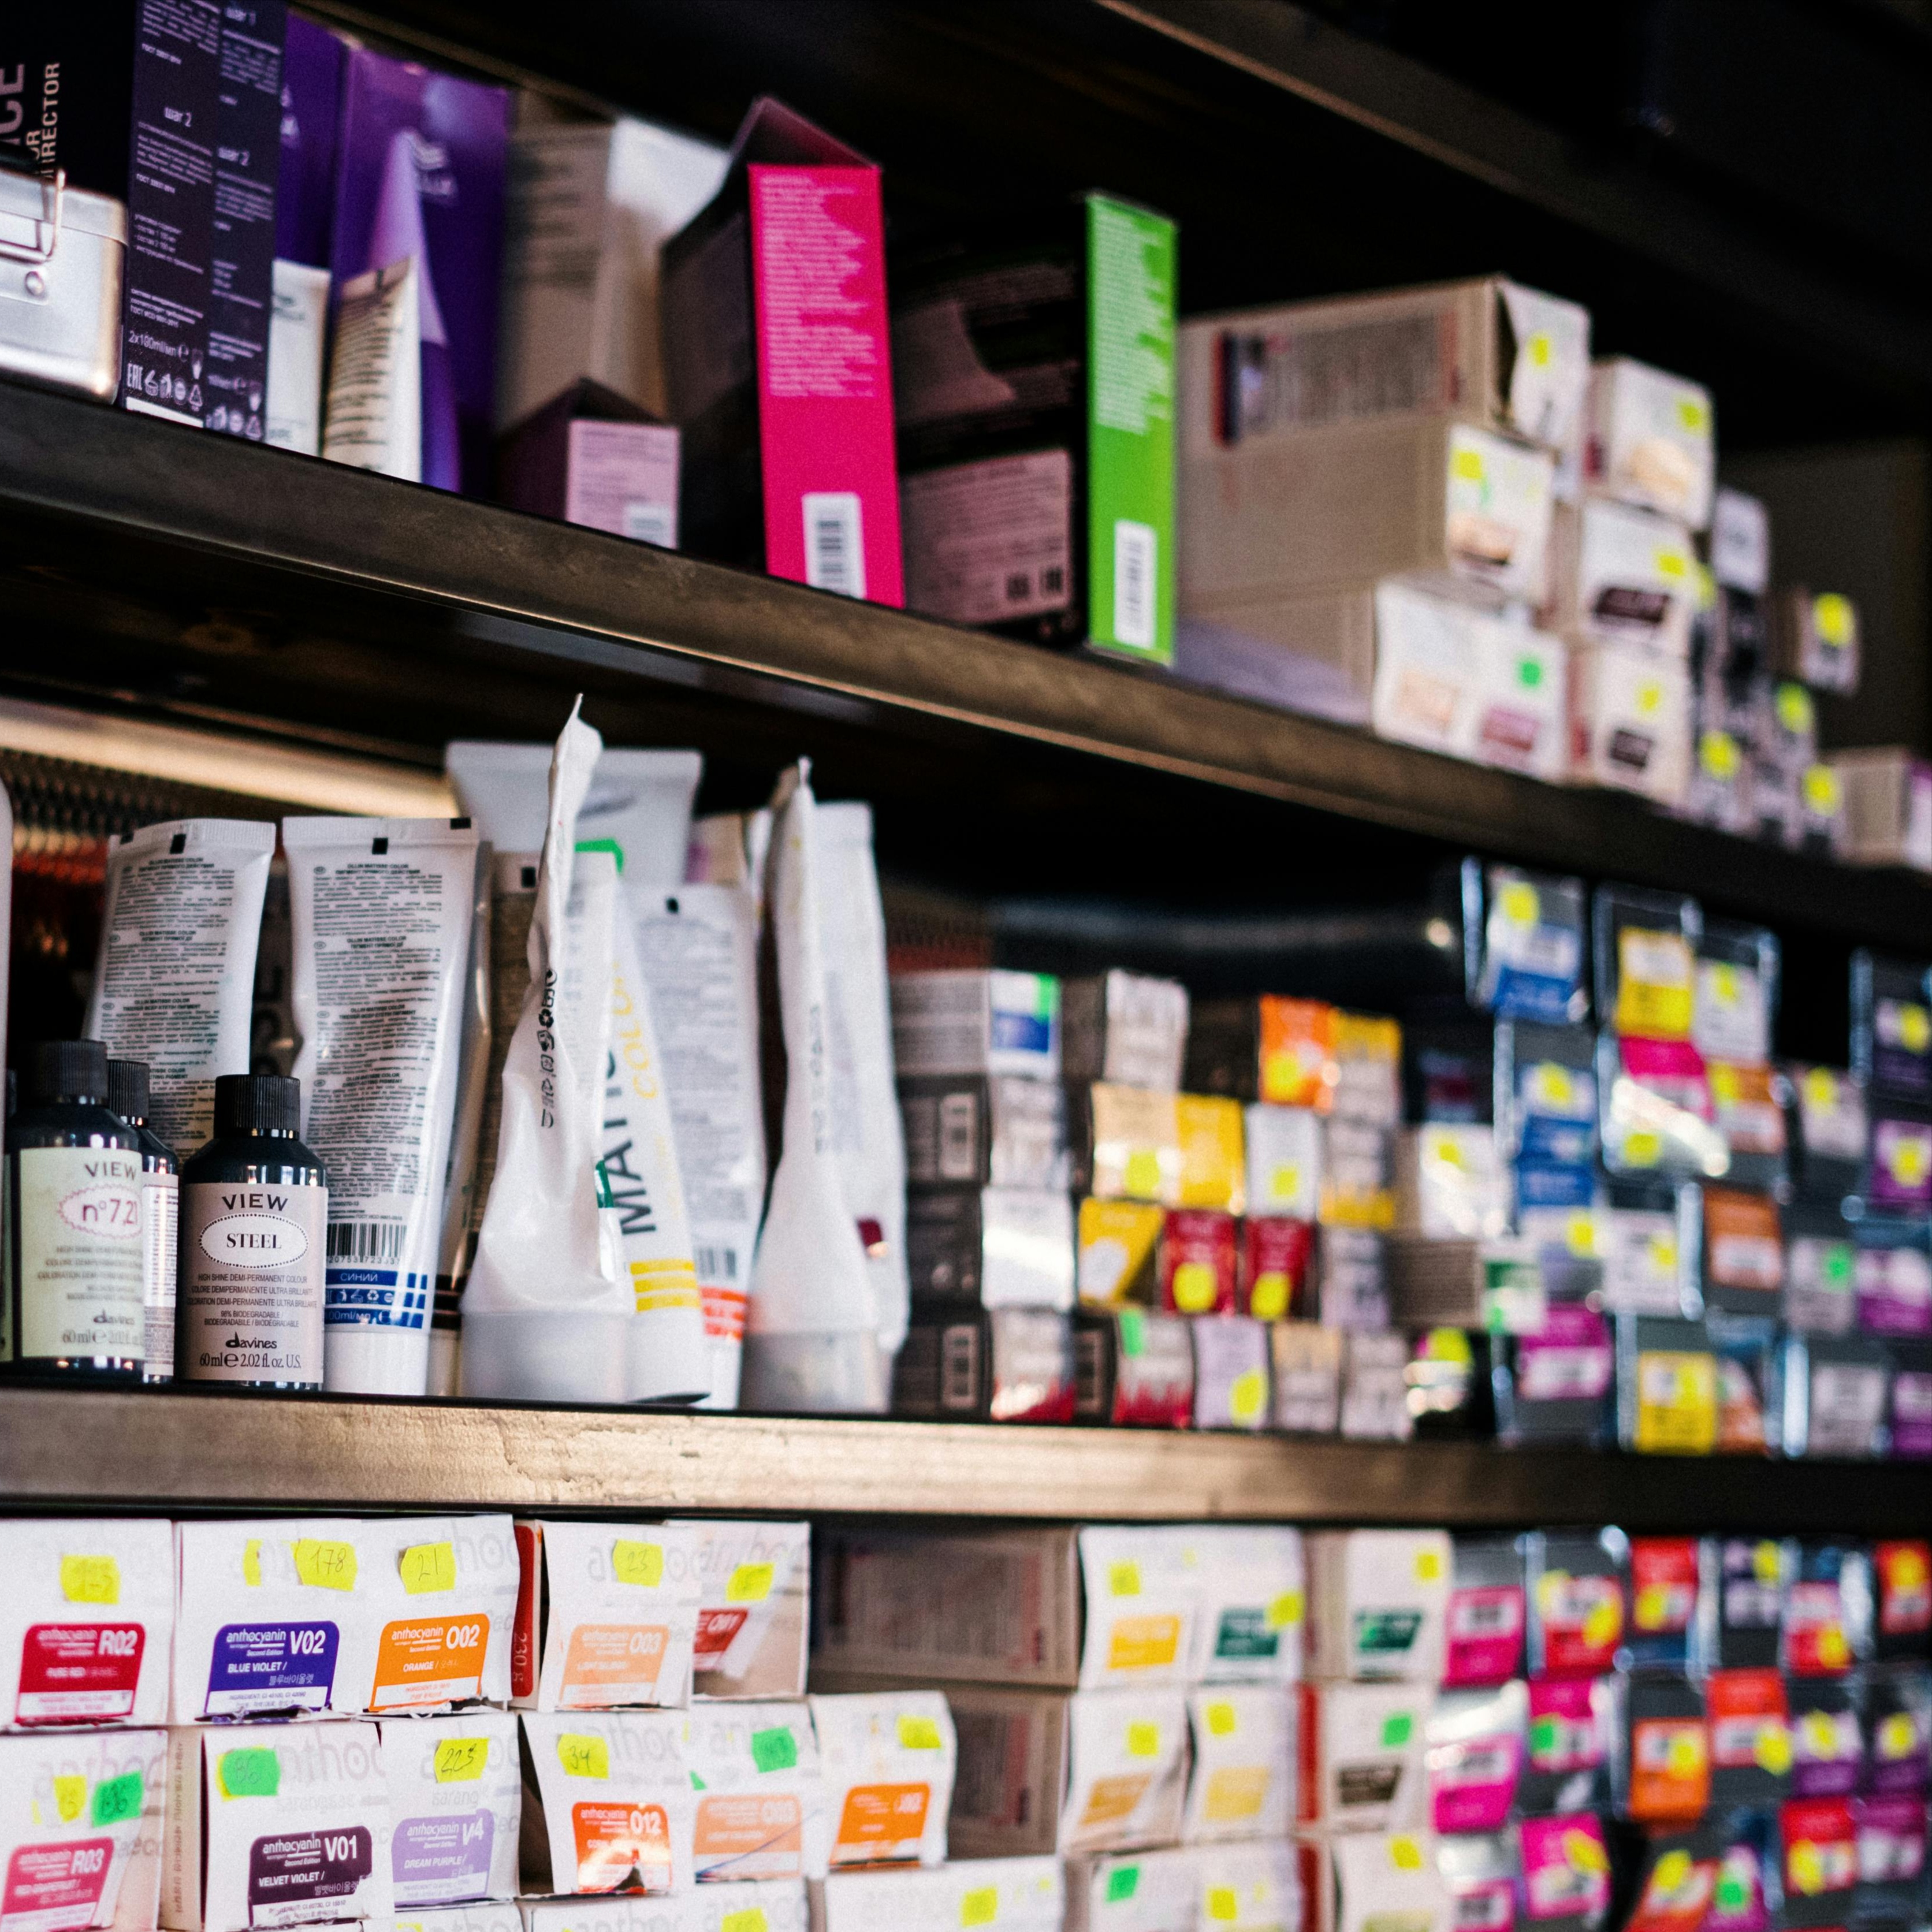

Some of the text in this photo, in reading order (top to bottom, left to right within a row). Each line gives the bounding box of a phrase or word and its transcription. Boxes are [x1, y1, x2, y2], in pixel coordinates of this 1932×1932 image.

[85, 1162, 136, 1181] VIEW
[221, 1193, 288, 1211] VIEW
[226, 1233, 282, 1249] STEEL
[230, 1274, 286, 1282] DEMI-PERMANENT
[211, 1286, 268, 1294] DEMIPERMANENTE
[269, 1287, 288, 1295] ULTRA
[216, 1298, 276, 1306] DEMI-PERMANENTE
[226, 1331, 277, 1349] davines
[240, 1353, 260, 1368] 2.02
[310, 1545, 347, 1574] 178
[418, 1547, 438, 1581] 21
[226, 1628, 326, 1655] anthocyanin V02
[392, 1626, 444, 1641] anthocyanin
[98, 1629, 138, 1656] R02
[228, 1663, 250, 1673] BLUE
[252, 1661, 281, 1672] VIOLET
[403, 1661, 434, 1673] ORANGE
[407, 1822, 460, 1838] anthocyanin
[263, 1835, 357, 1862] anthocyanin V01
[71, 1848, 105, 1875] R03
[404, 1857, 432, 1869] DREAM
[259, 1875, 289, 1887] VELVET
[291, 1872, 319, 1883] VIOLET
